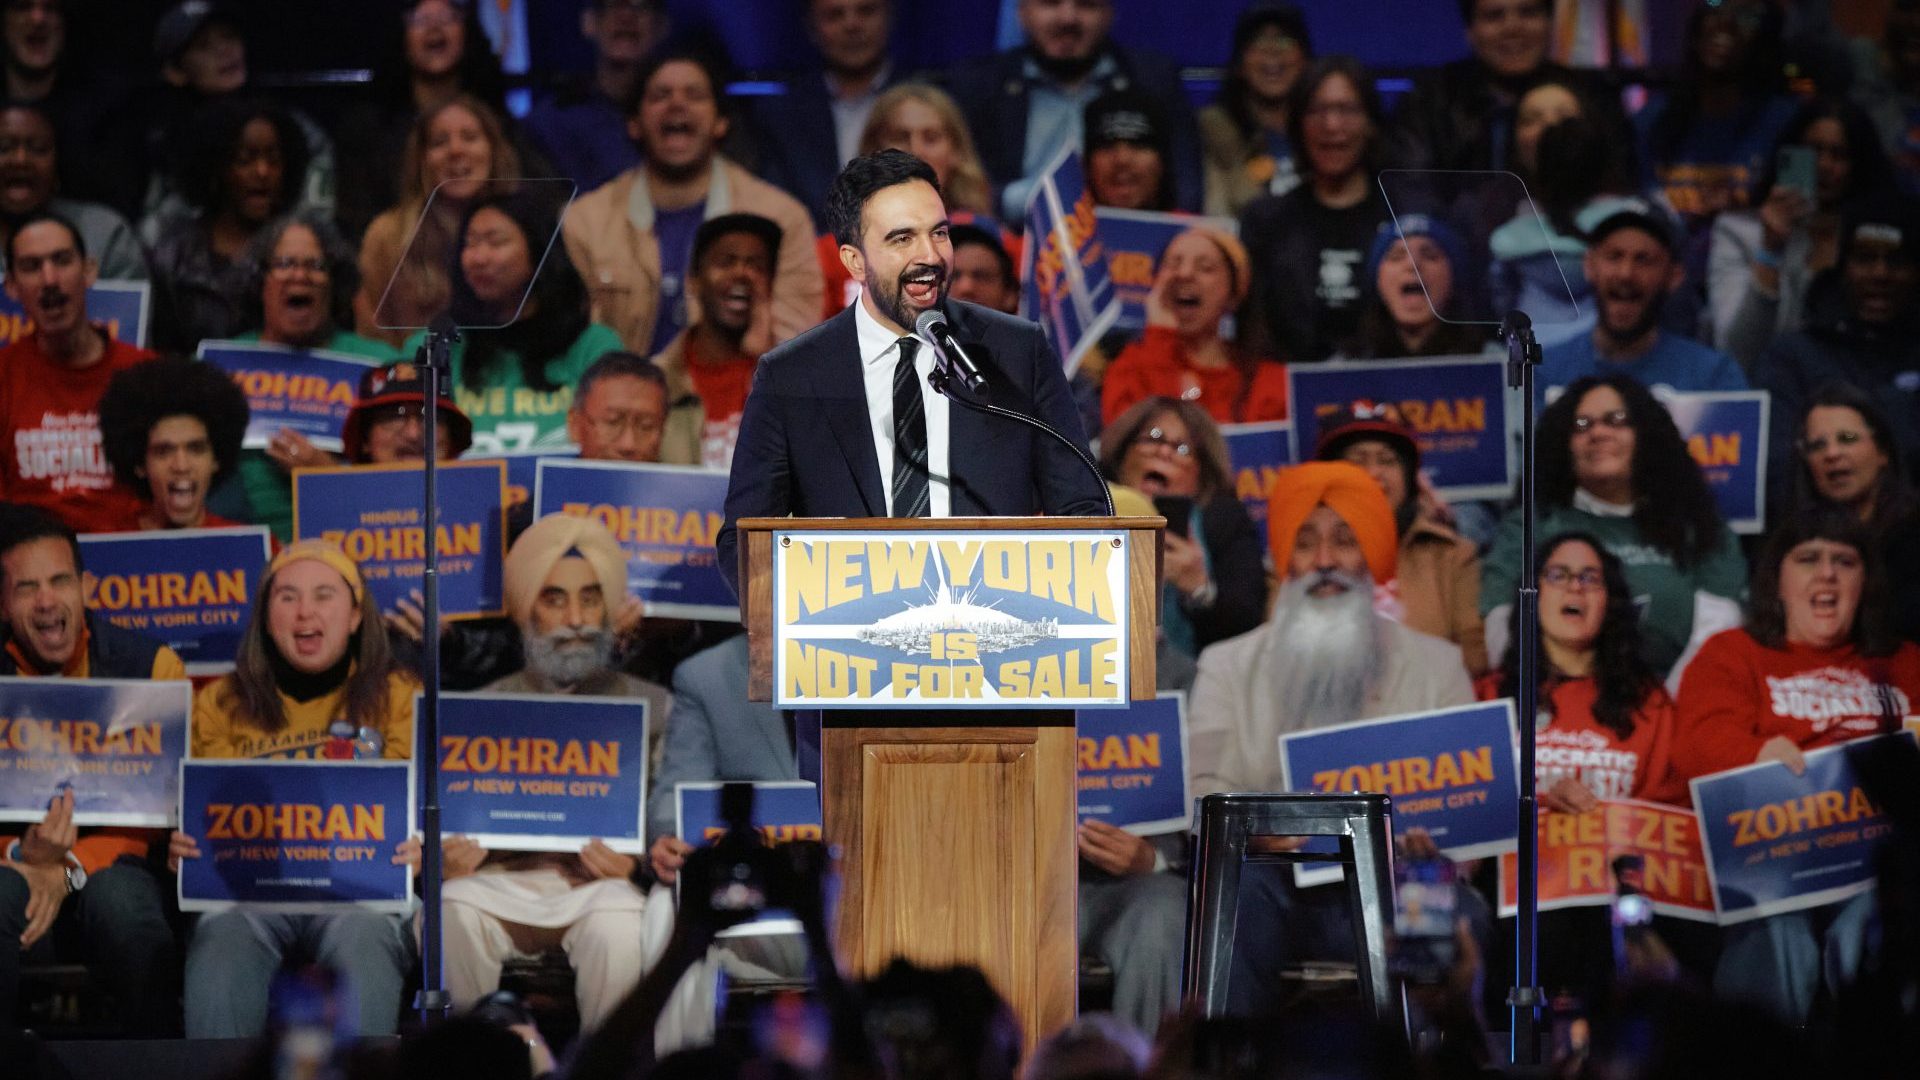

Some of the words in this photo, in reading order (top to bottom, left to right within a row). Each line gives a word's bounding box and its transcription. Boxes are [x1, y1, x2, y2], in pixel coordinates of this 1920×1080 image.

[231, 370, 354, 408] OHRA
[16, 445, 110, 479] SOCIALI
[563, 503, 727, 549] OHRA
[785, 541, 930, 626] NEW
[937, 541, 1117, 625] YORK
[153, 611, 199, 628] YORK
[202, 608, 241, 625] CITY
[931, 632, 978, 660] IS
[785, 640, 878, 698] NOT
[892, 662, 984, 698] FOR
[999, 637, 1118, 698] SALE
[1771, 688, 1911, 721] SOCIAL
[440, 735, 620, 778] ZOHRAN
[1078, 732, 1161, 772] RAN
[1536, 748, 1638, 772] OCRATIC
[473, 779, 515, 795] NEW
[519, 781, 565, 797] YORK
[569, 782, 610, 799] CITY
[1313, 747, 1496, 796] ZOHRAN
[1447, 791, 1488, 809] CITY
[1727, 786, 1885, 848] ZOHRA
[205, 803, 385, 841] ZOHRAN
[240, 847, 280, 861] NEW
[284, 847, 331, 861] YORK
[335, 847, 376, 861] CITY
[1769, 841, 1811, 860] NEW
[1815, 831, 1860, 849] YORK
